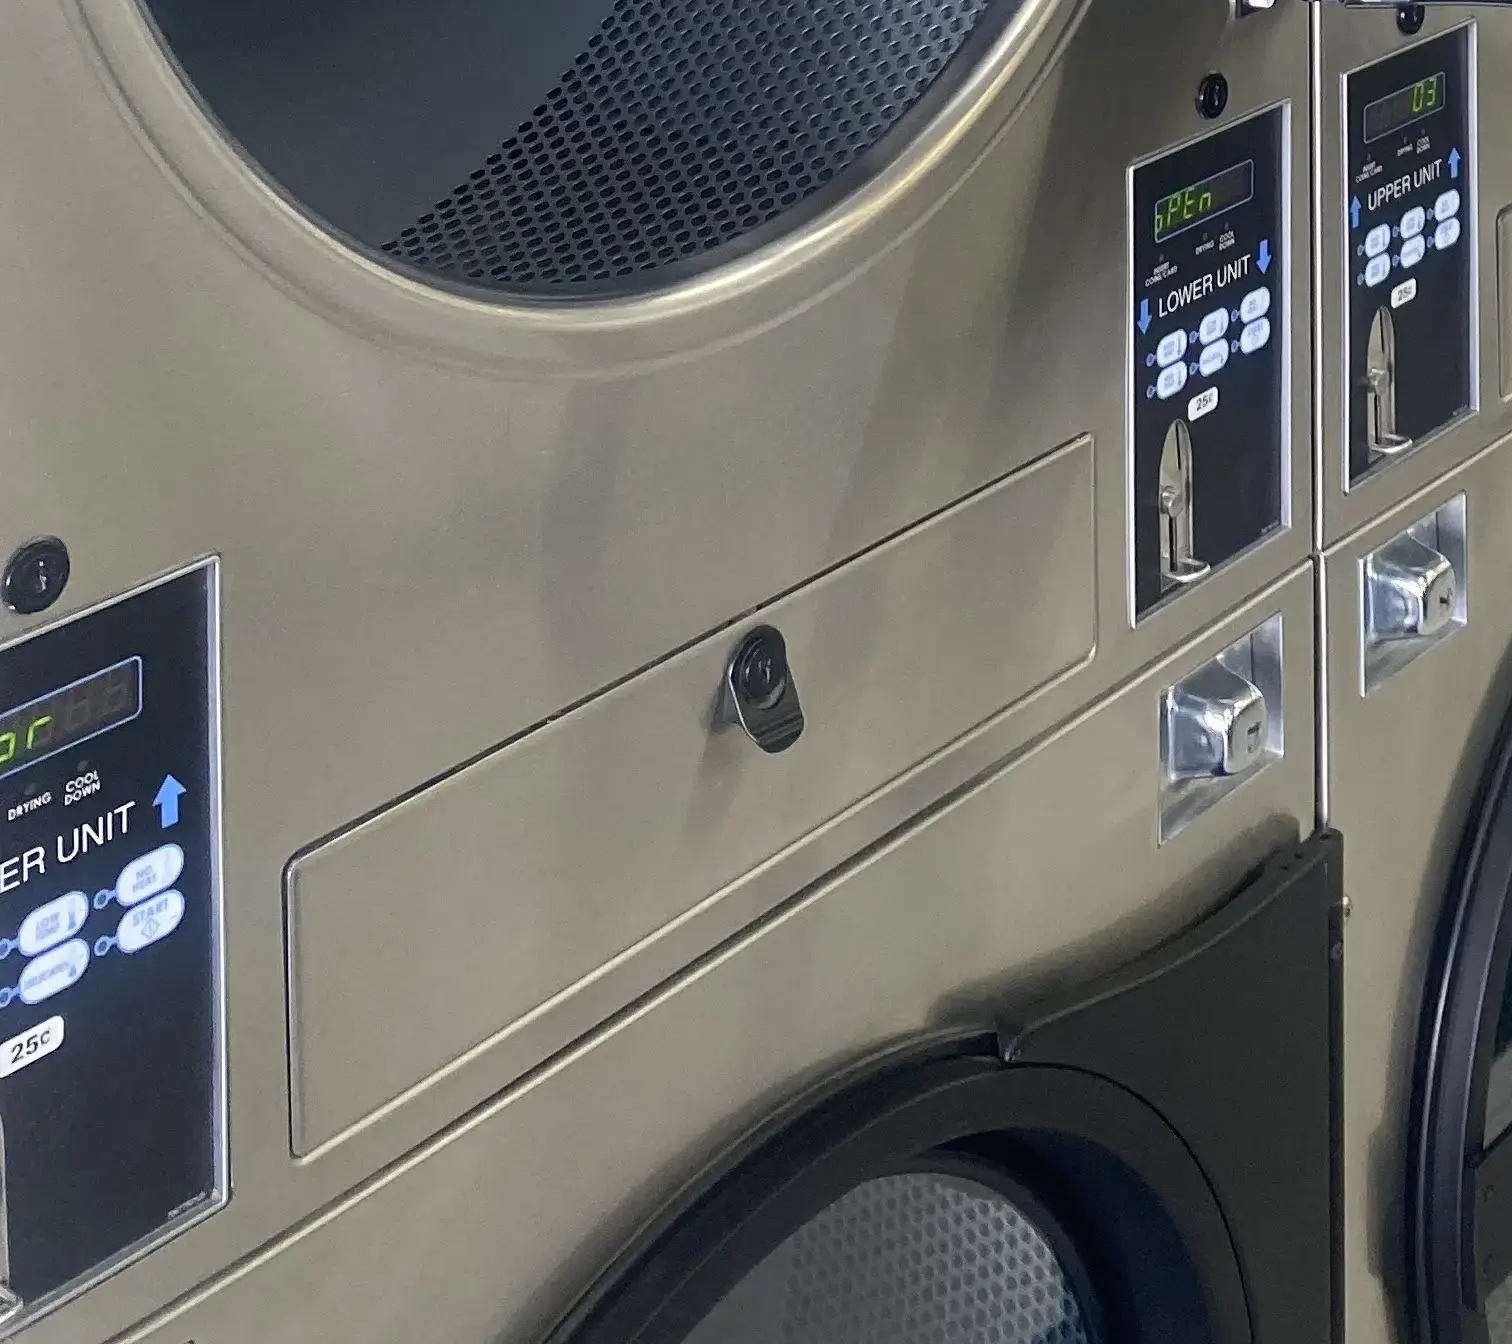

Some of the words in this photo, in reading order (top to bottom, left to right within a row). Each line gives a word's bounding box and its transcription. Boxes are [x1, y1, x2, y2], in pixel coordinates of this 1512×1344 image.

[1412, 76, 1437, 113] 03
[1367, 174, 1411, 211] UPPER
[1413, 159, 1442, 189] UNIT
[1158, 273, 1213, 318] LOWER
[1216, 254, 1251, 288] UNIT
[8, 791, 51, 821] DRYING
[65, 769, 100, 793] COOL
[64, 779, 101, 806] DOWN
[57, 800, 136, 864] UNIT
